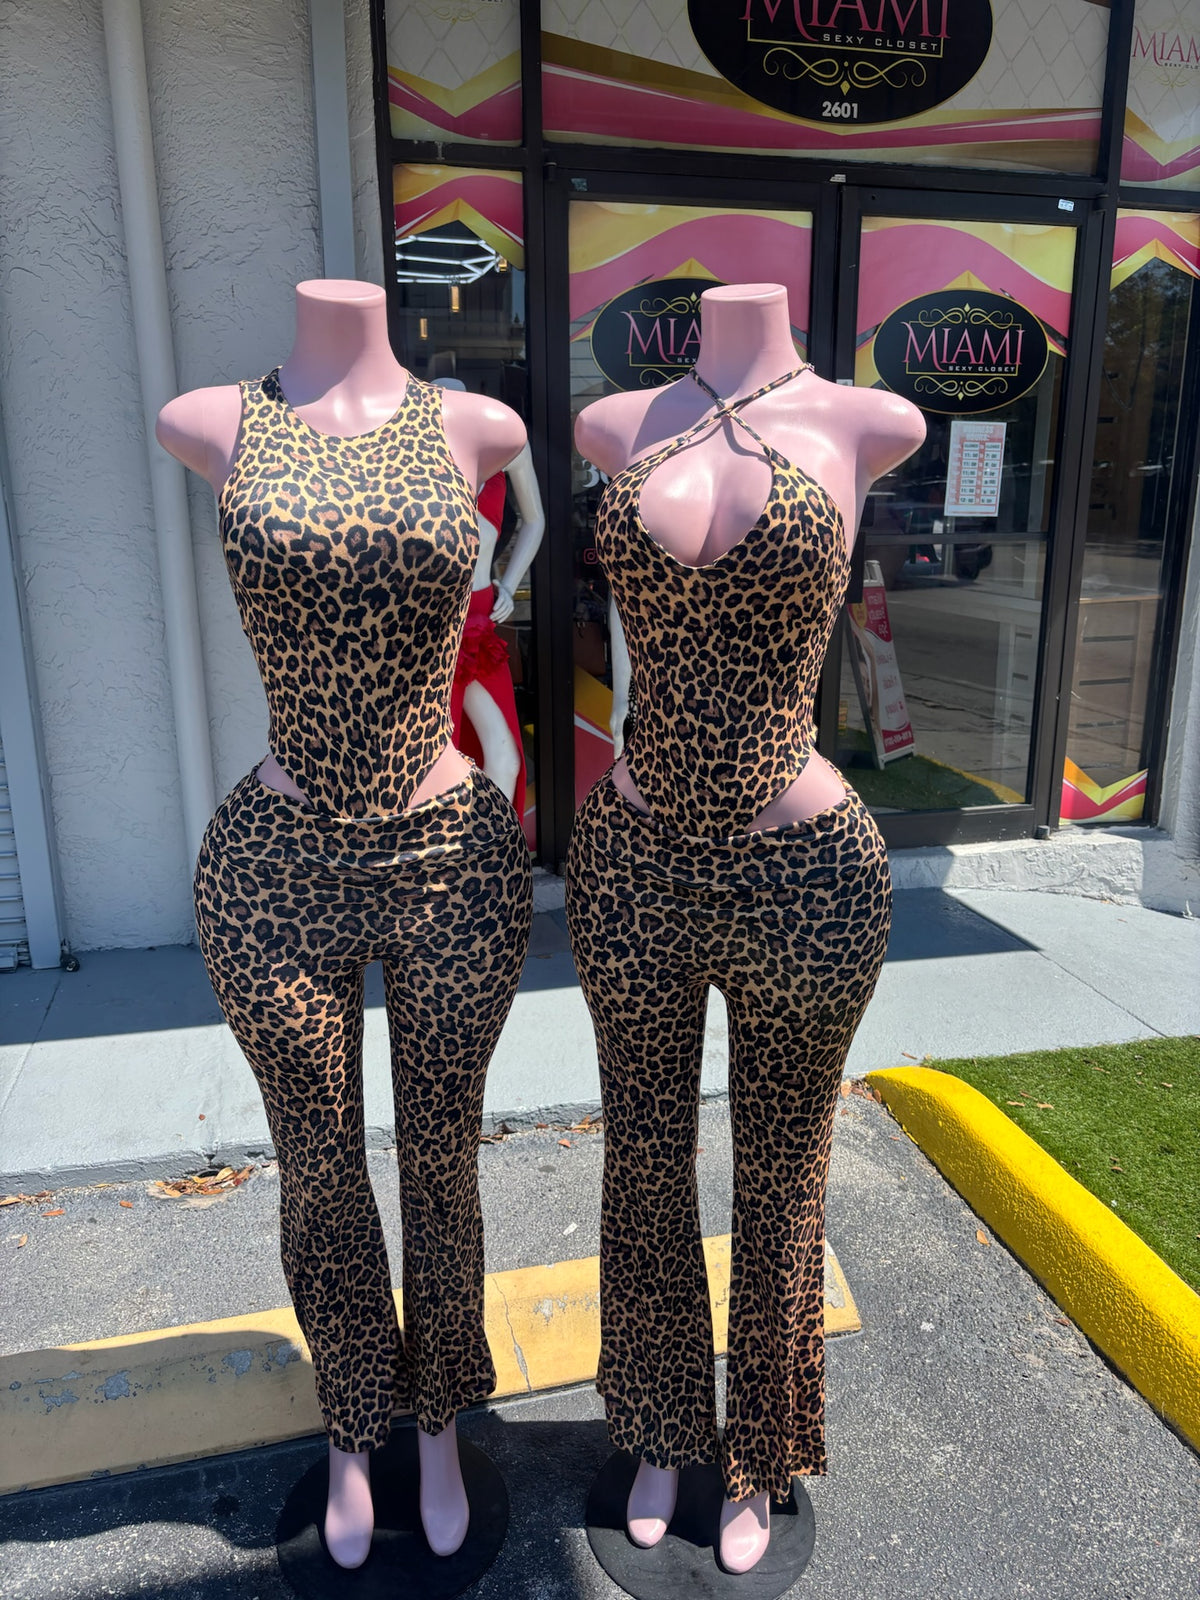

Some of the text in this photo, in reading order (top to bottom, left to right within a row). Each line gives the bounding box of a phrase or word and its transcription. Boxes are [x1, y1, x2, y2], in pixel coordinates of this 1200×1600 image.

[823, 33, 938, 52] SEXY CLOSET
[821, 100, 859, 119] 2601
[900, 321, 1026, 372] MIAMI
